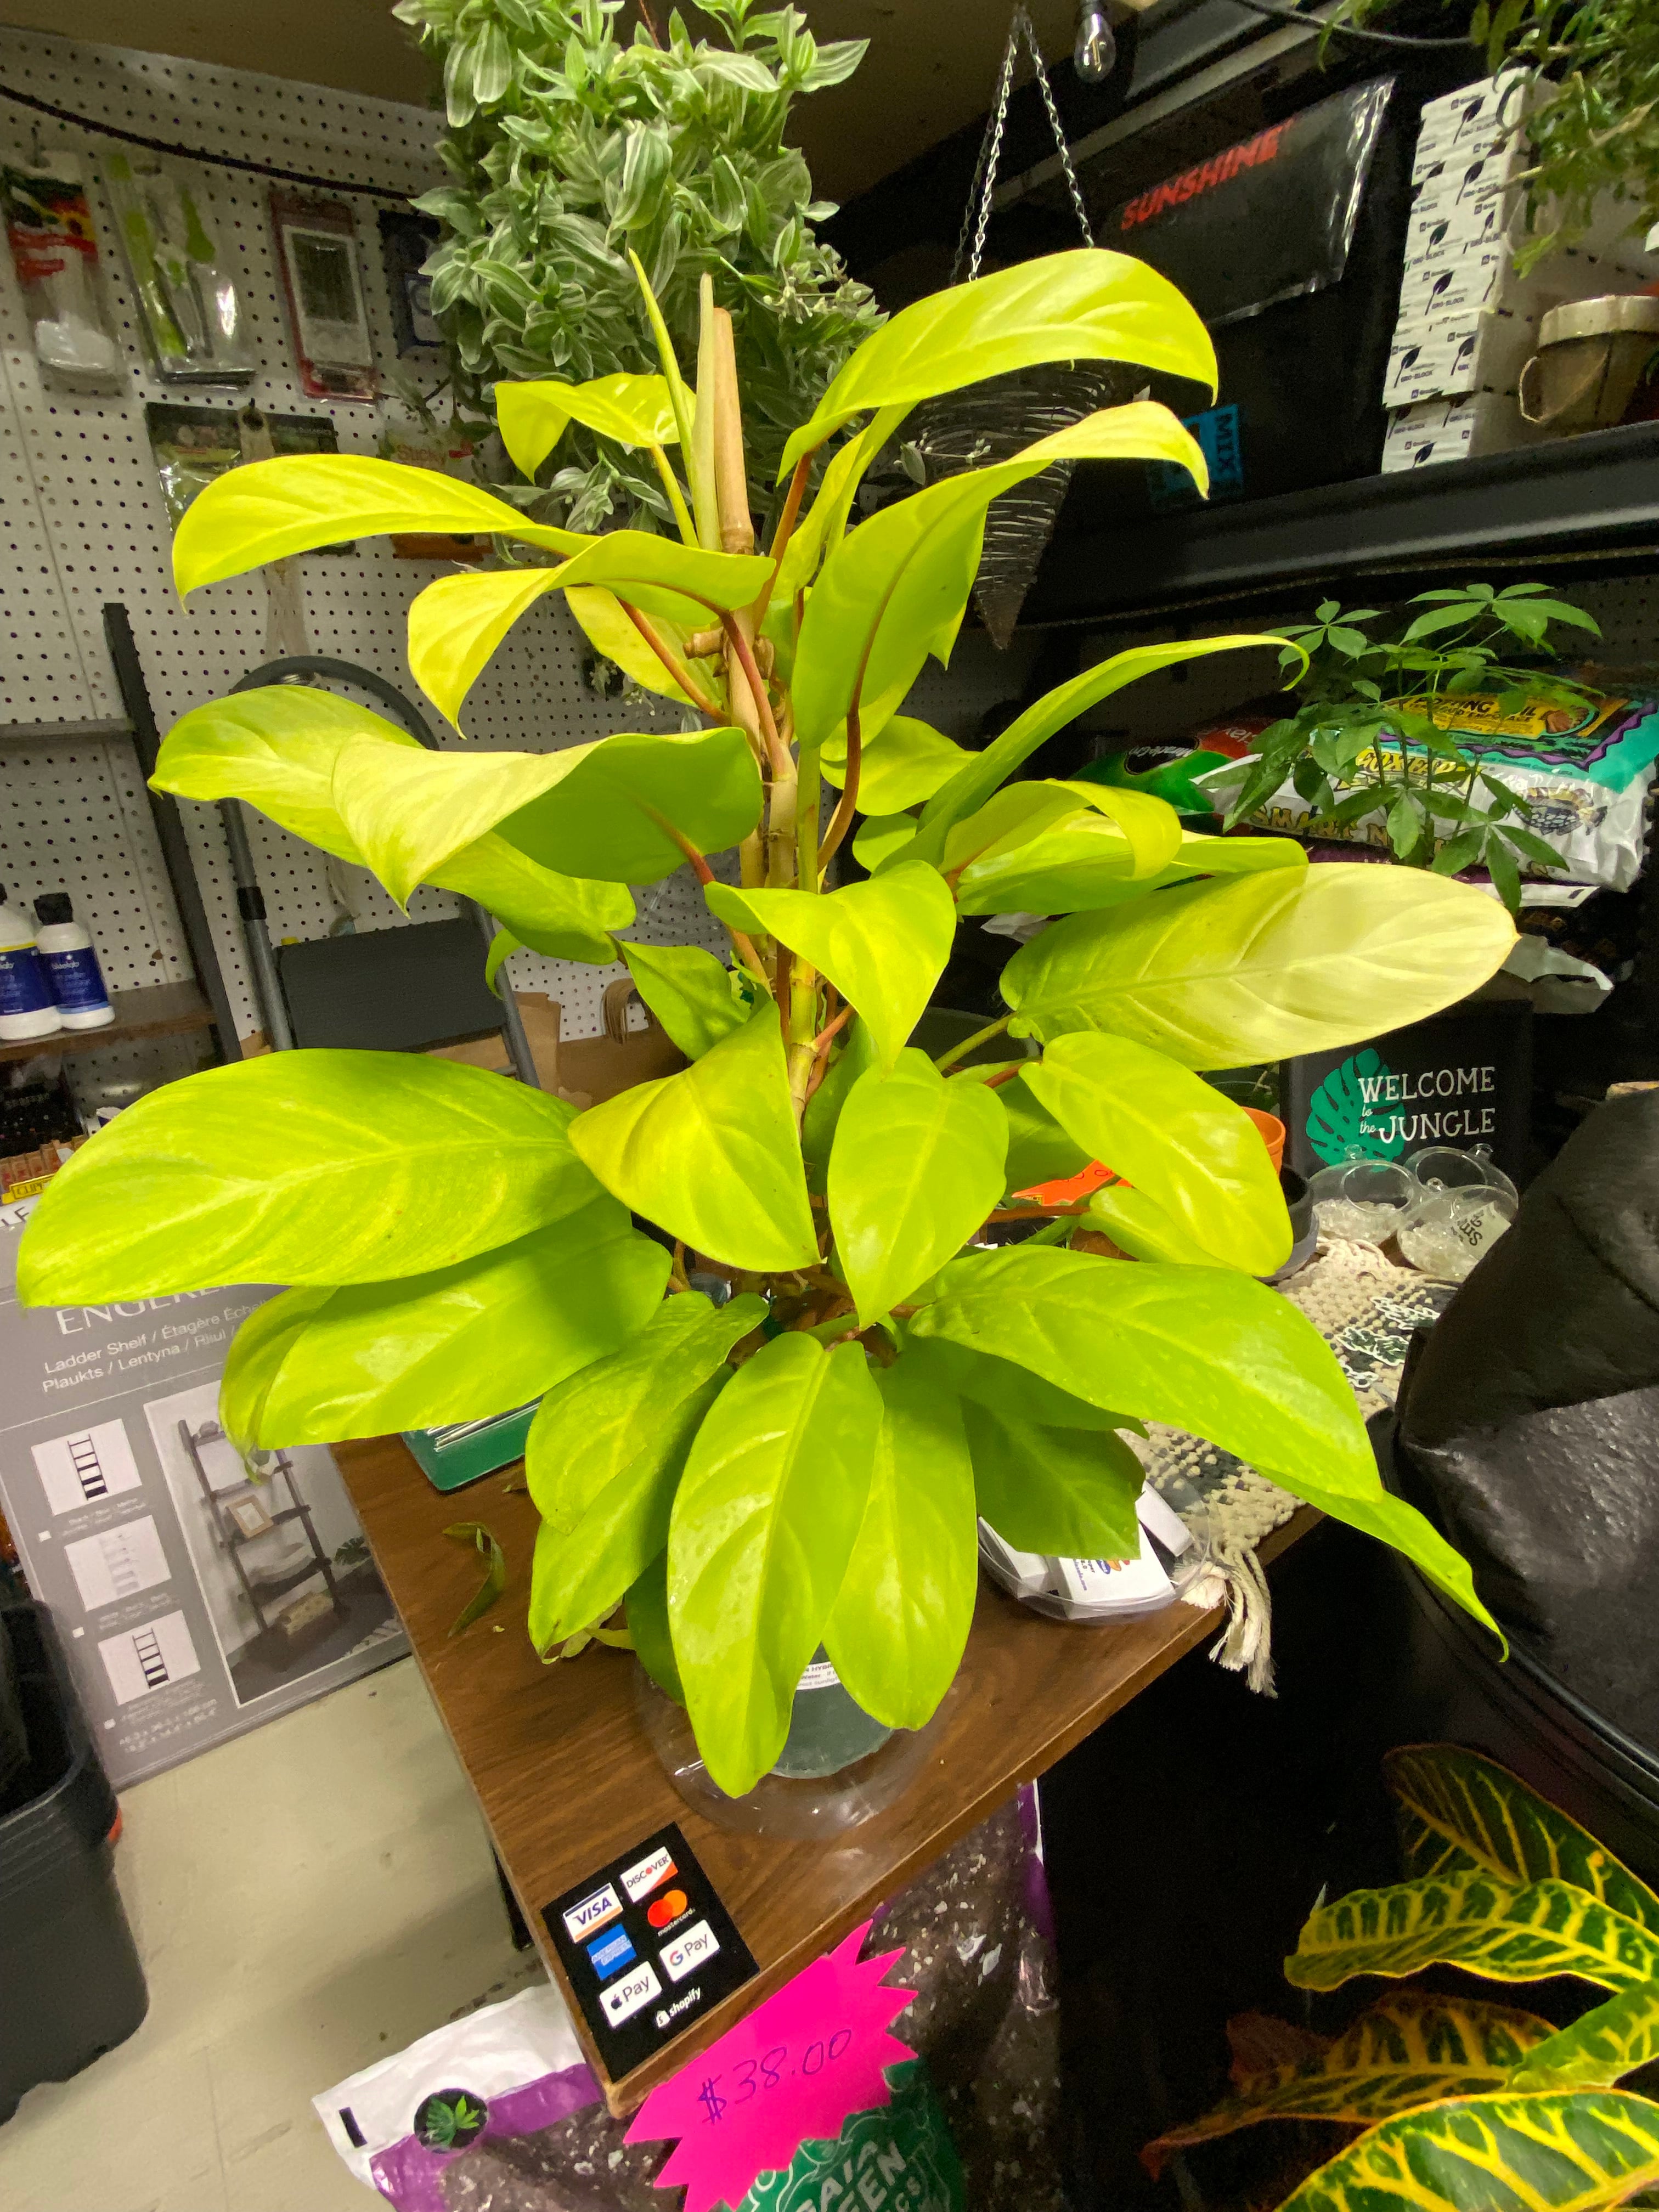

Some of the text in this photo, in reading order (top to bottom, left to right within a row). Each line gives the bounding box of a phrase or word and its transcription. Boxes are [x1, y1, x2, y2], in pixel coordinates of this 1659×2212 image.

[1121, 118, 1294, 230] SUNSHINE
[1215, 413, 1234, 473] MIX
[1358, 1066, 1496, 1103] WELCOME
[1359, 1108, 1496, 1144] the JUNGLE
[1362, 1104, 1373, 1117] to
[44, 1348, 102, 1374] Ladder
[106, 1334, 148, 1355] Shelf
[161, 1314, 220, 1340] Étagère
[42, 1367, 104, 1393] Plaukts
[119, 1344, 180, 1370] Lentyna
[627, 1855, 668, 1888] DISCOVER
[572, 1896, 612, 1926] VISA
[657, 1909, 693, 1937] mastercard
[684, 1933, 709, 1957] Pay
[622, 1976, 651, 2002] Pay
[669, 1986, 702, 2017] shopify
[698, 2029, 852, 2125] $38.00
